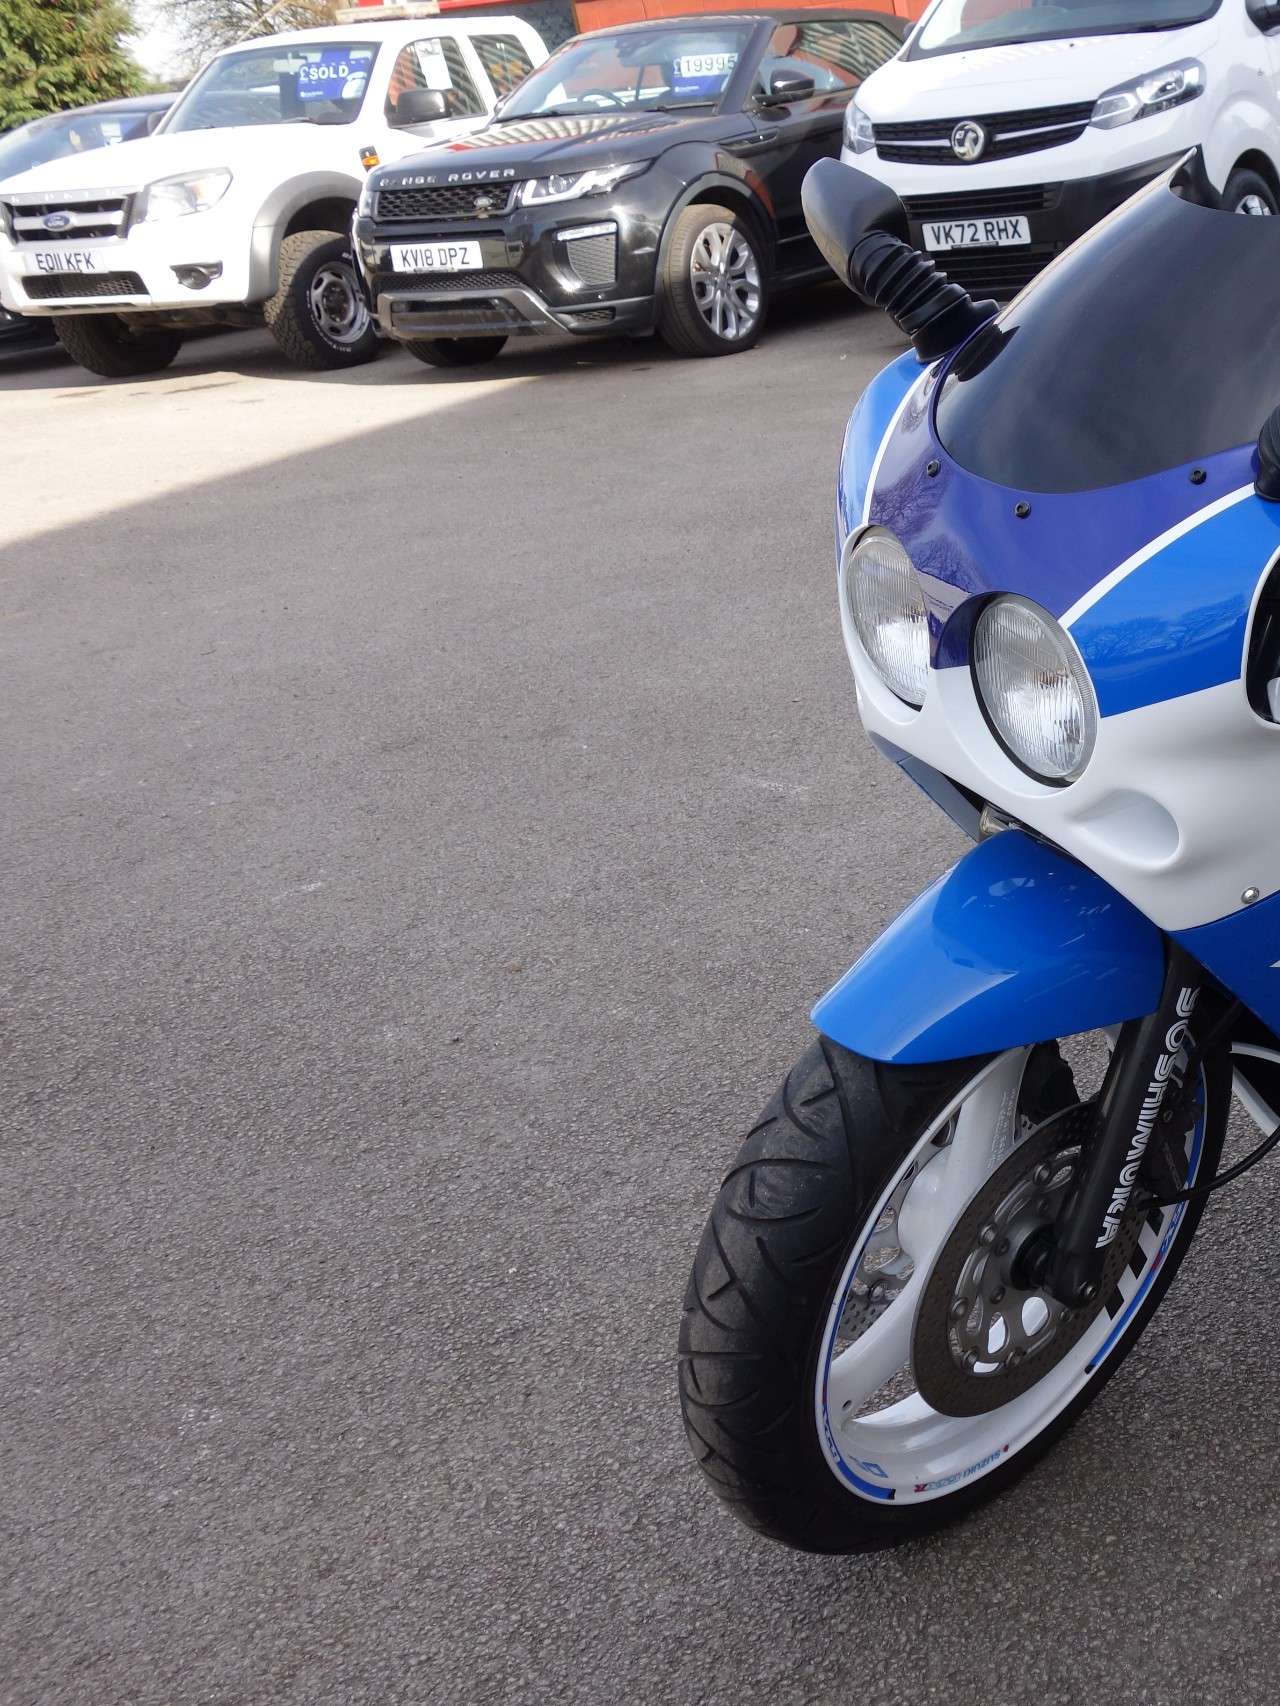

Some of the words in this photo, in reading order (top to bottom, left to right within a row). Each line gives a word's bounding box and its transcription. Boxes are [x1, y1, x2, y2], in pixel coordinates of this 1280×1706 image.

[448, 168, 516, 182] ROVER
[931, 223, 980, 245] VK72
[983, 219, 1022, 241] RHX
[65, 252, 95, 271] KFK
[401, 248, 433, 268] KV18
[438, 247, 470, 266] DPZ
